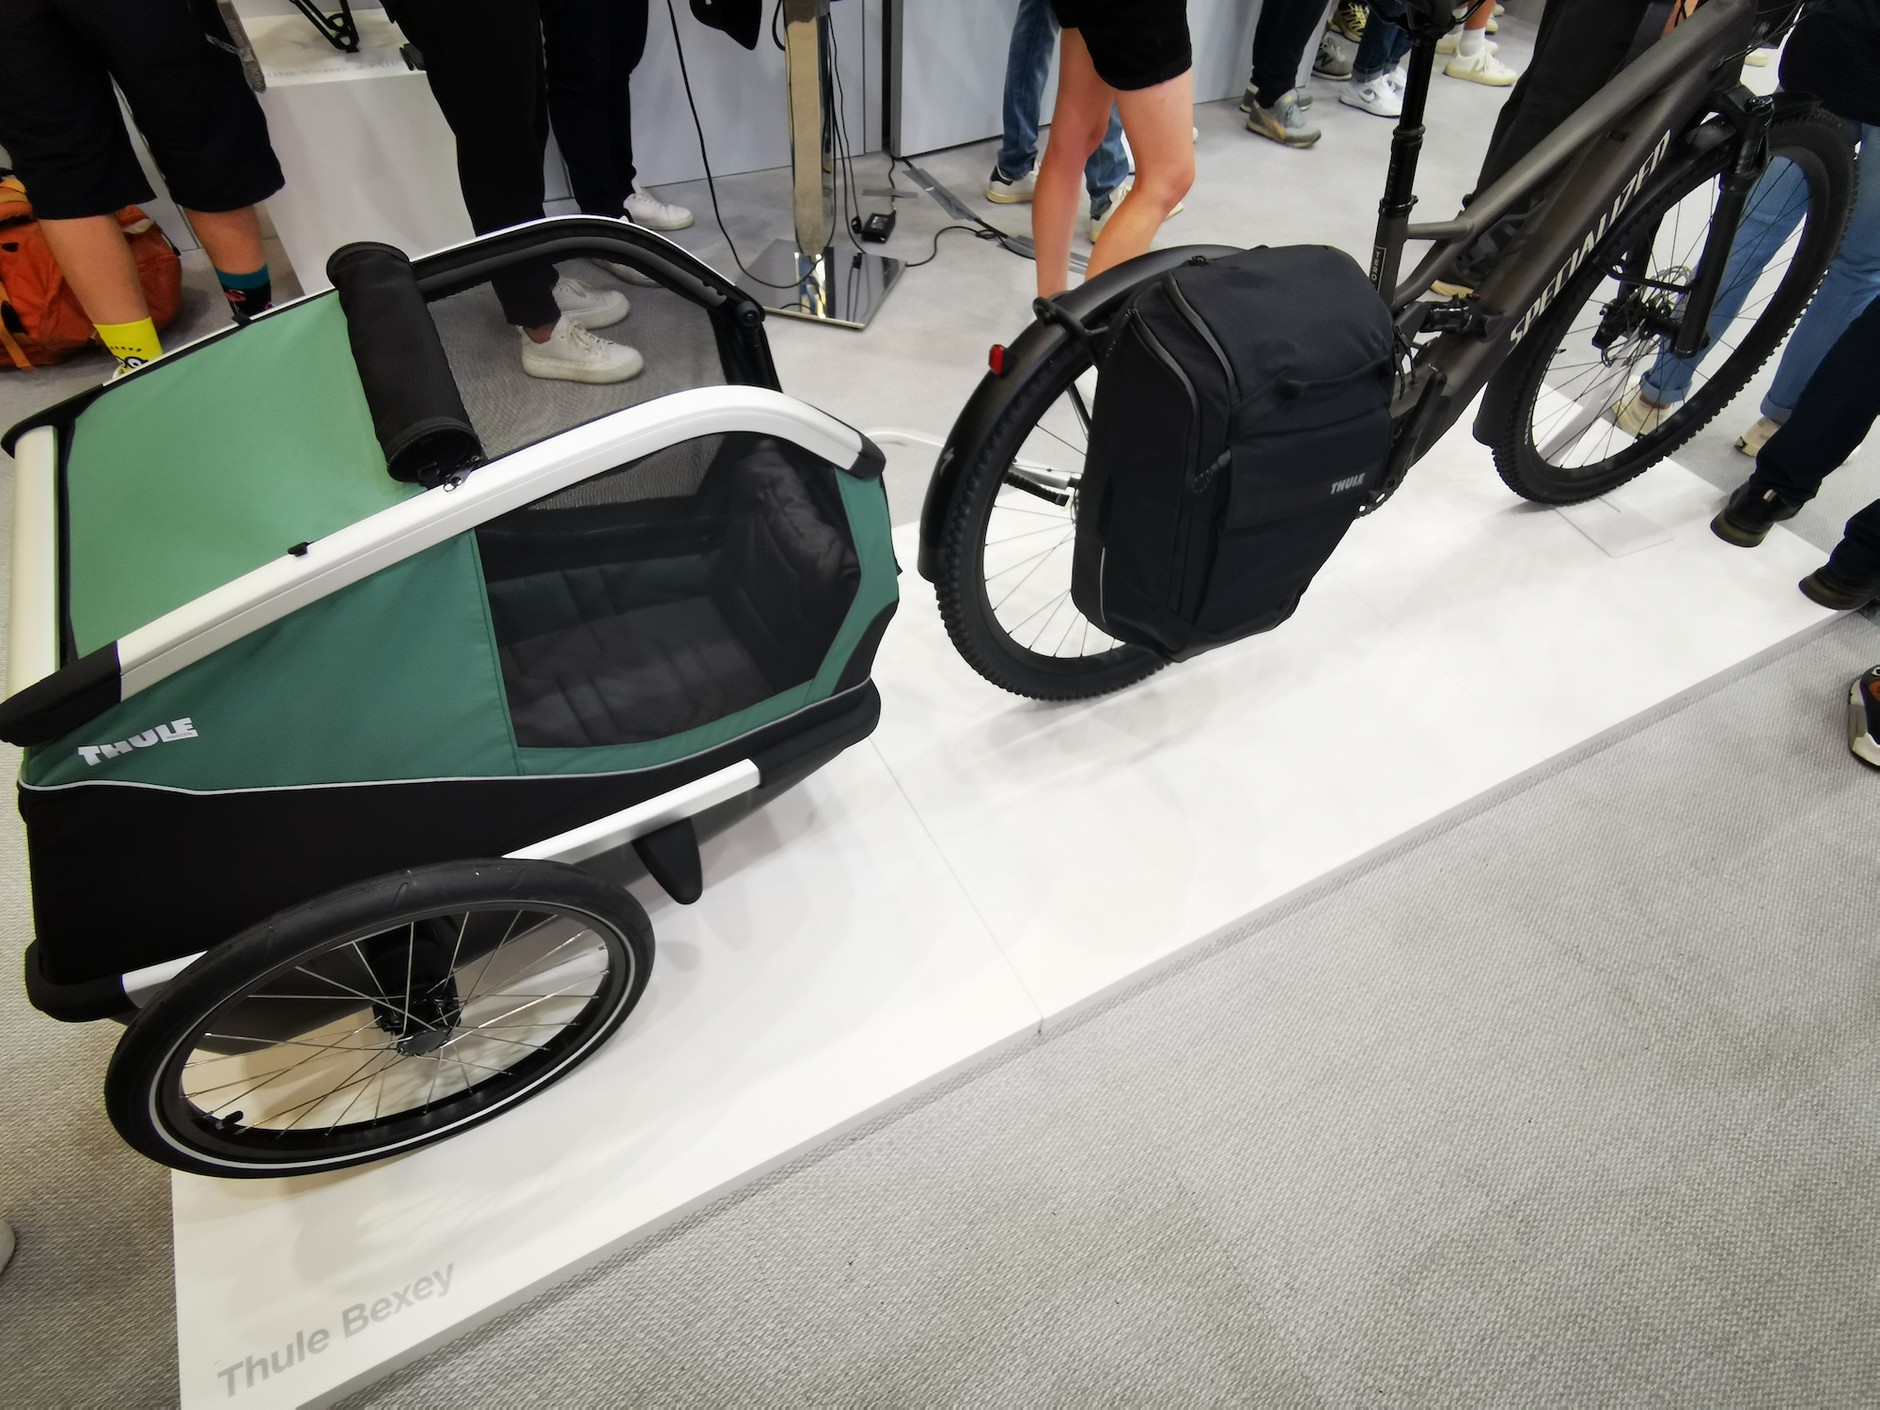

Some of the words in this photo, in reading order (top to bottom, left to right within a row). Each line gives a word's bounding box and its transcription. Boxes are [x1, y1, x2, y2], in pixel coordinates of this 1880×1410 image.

[1371, 251, 1381, 281] TERO
[1508, 129, 1671, 355] SPECIALIZED
[1330, 472, 1366, 494] THULE
[77, 717, 198, 766] THULE
[217, 1328, 330, 1398] Thule
[341, 1263, 454, 1339] Bexey
